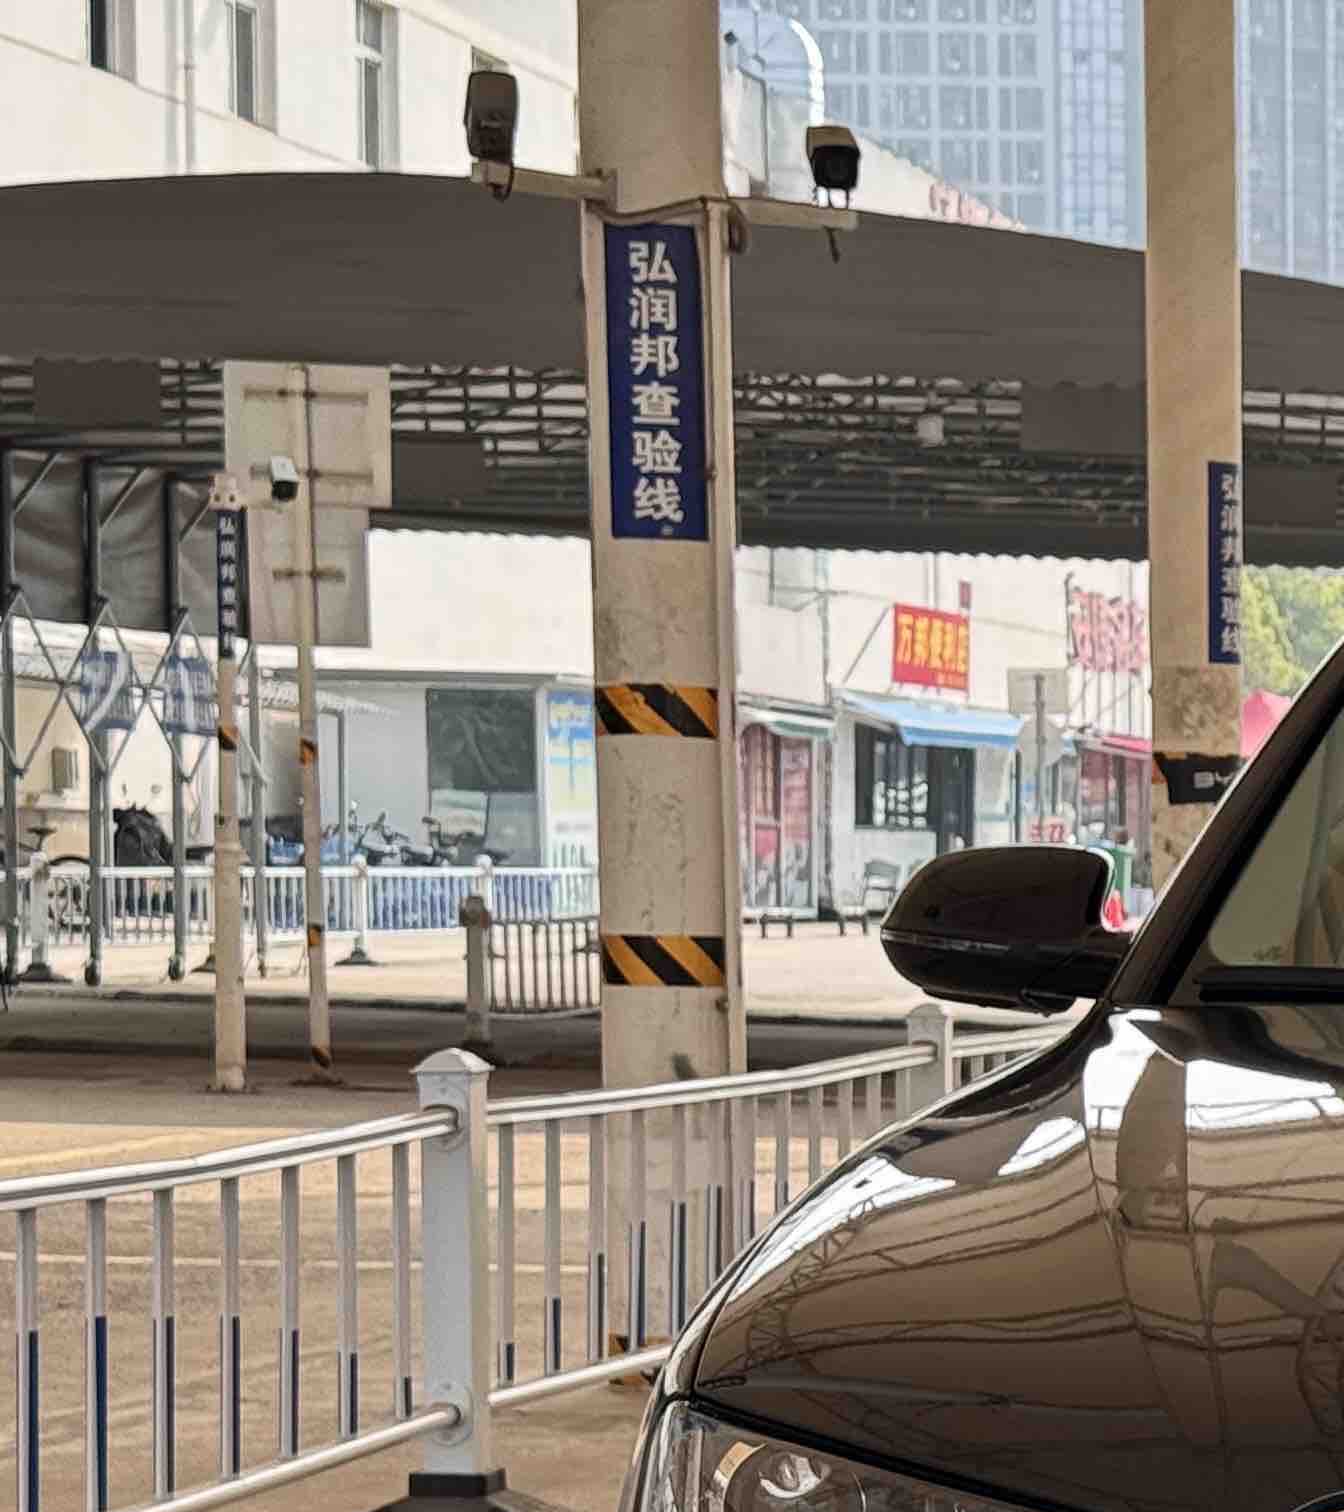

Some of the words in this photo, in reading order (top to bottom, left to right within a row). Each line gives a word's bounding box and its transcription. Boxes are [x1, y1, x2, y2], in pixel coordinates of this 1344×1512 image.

[628, 241, 684, 523] 弘润邦查验线
